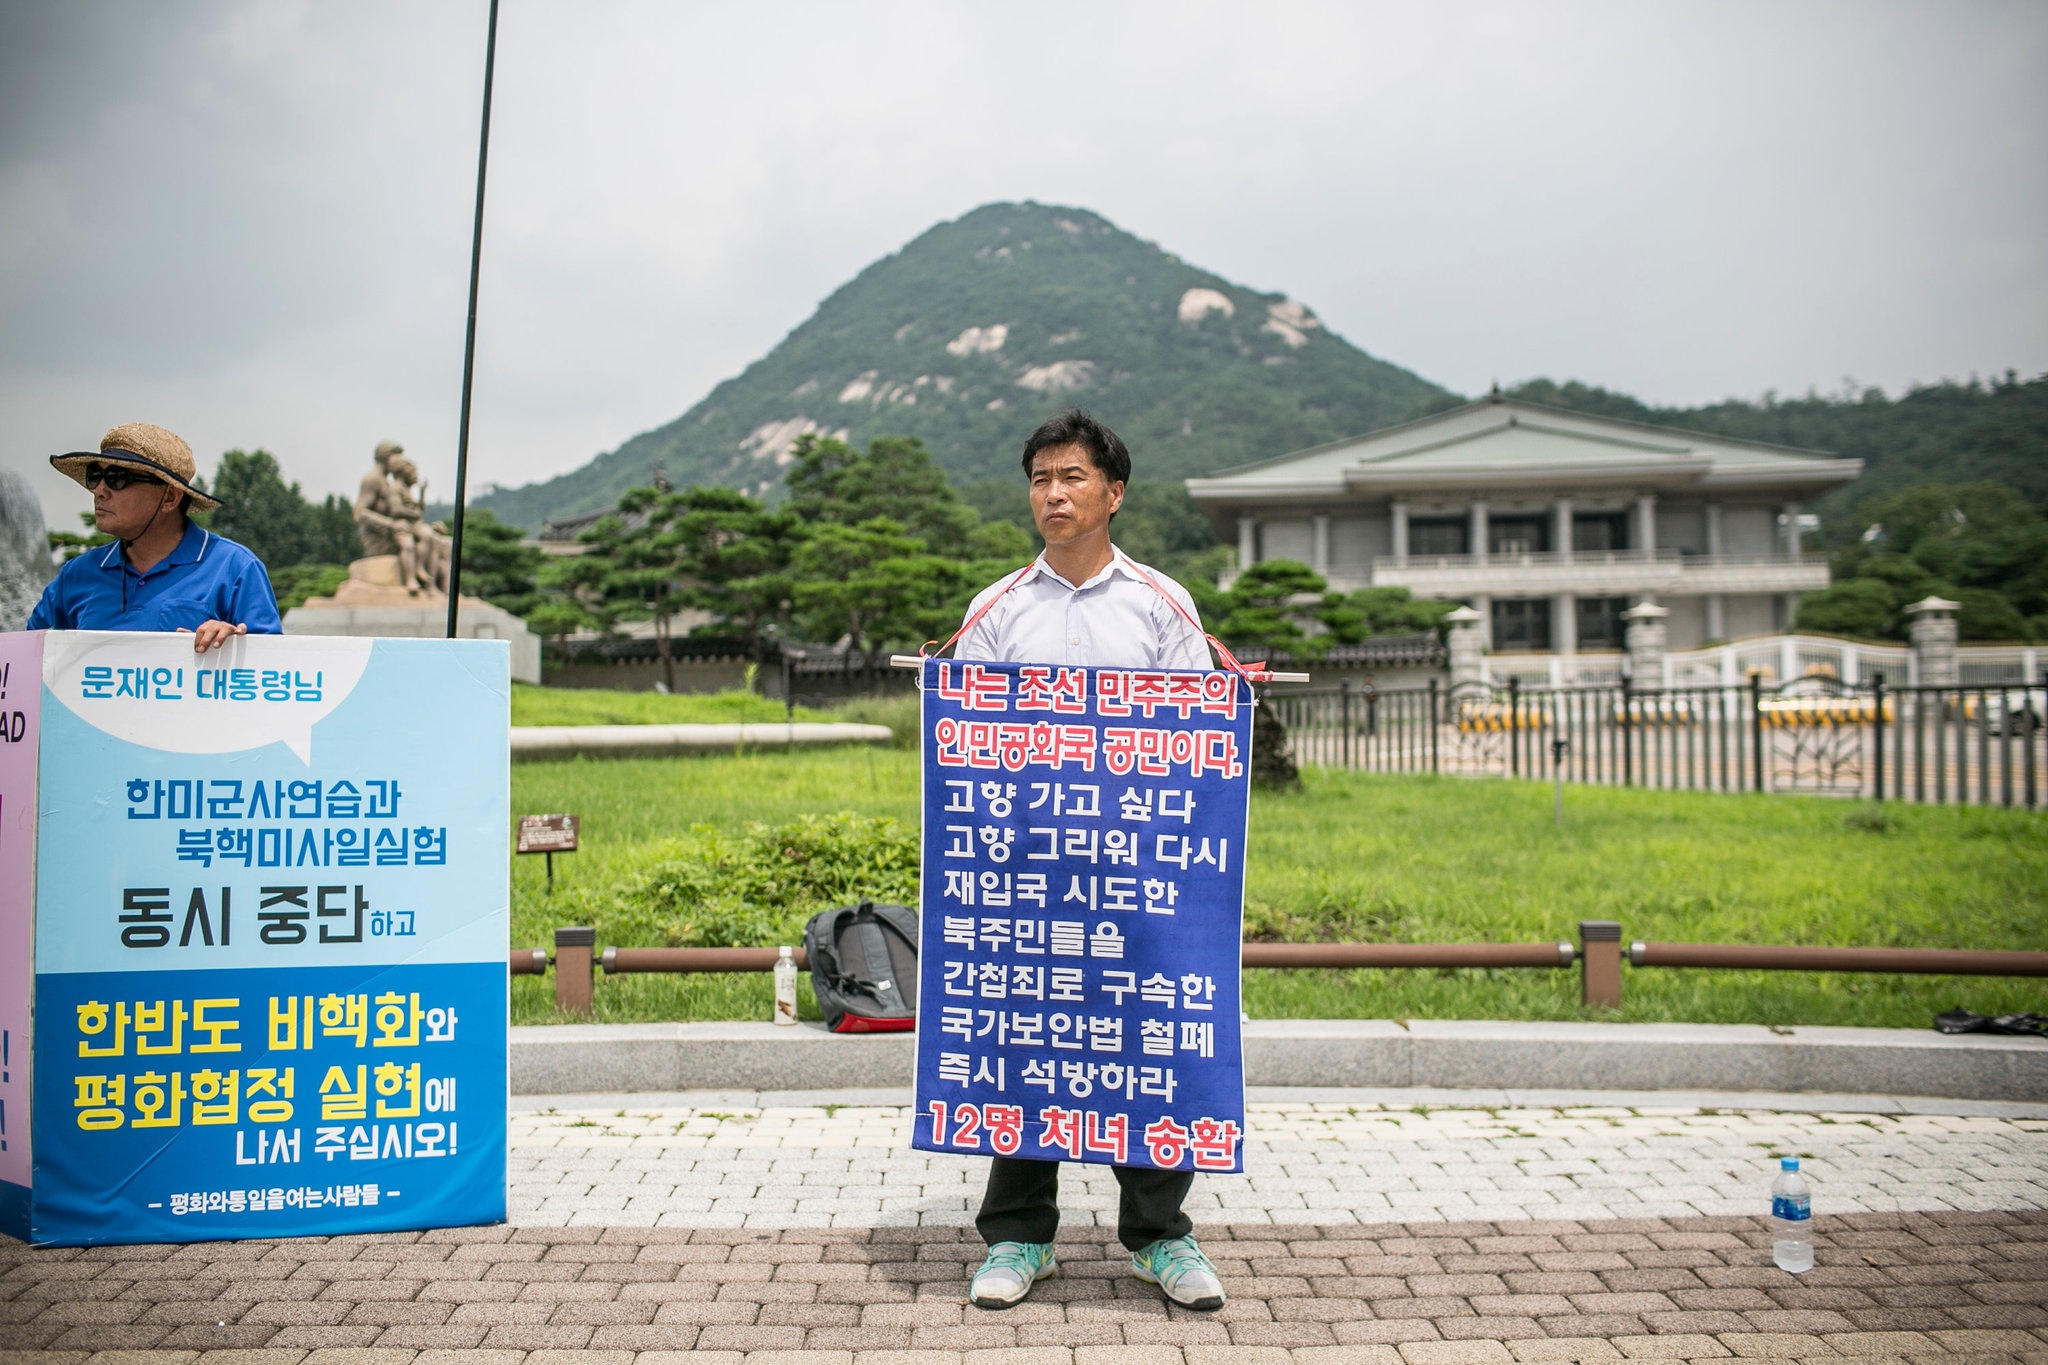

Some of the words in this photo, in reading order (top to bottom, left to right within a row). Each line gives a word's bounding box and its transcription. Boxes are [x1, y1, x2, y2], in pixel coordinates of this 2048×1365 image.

[81, 667, 182, 699] 문재인
[197, 669, 321, 701] 대통령님
[938, 663, 1010, 711] 나는
[1016, 665, 1088, 714] 조선
[1096, 670, 1239, 720] 민주주의
[935, 717, 1097, 772] 인민공화국
[1102, 727, 1243, 779] 공민이다.
[127, 778, 401, 819] 한미군사연습과
[945, 780, 1016, 818] 고향
[1029, 783, 1101, 816] 가고
[1119, 787, 1196, 824] 싶다
[176, 826, 446, 868] 북핵미사일실험
[945, 825, 1015, 862] 고향
[1028, 828, 1137, 866] 그리워
[1156, 835, 1227, 872] 다시
[944, 871, 1047, 907] 재입국
[1064, 875, 1178, 915] 시도한
[119, 887, 231, 948] 동시
[944, 916, 1124, 958] 북주민들을
[944, 961, 1084, 1001] 간첩죄로
[1102, 971, 1216, 1010] 구속한
[77, 999, 241, 1057] 한반도
[941, 1007, 1122, 1053] 국가보안법
[1141, 1019, 1213, 1057] 철폐
[74, 1067, 295, 1131] 평화협정
[939, 1052, 1004, 1091] 즉시
[1022, 1060, 1177, 1103] 석방하라
[236, 1129, 300, 1164] 나서
[315, 1122, 456, 1161] 주십시오!
[928, 1101, 1023, 1156] 12명
[1039, 1106, 1129, 1160] 처녀
[1144, 1115, 1241, 1170] 송환
[170, 1184, 380, 1215] 평화와통일을여는사람들
